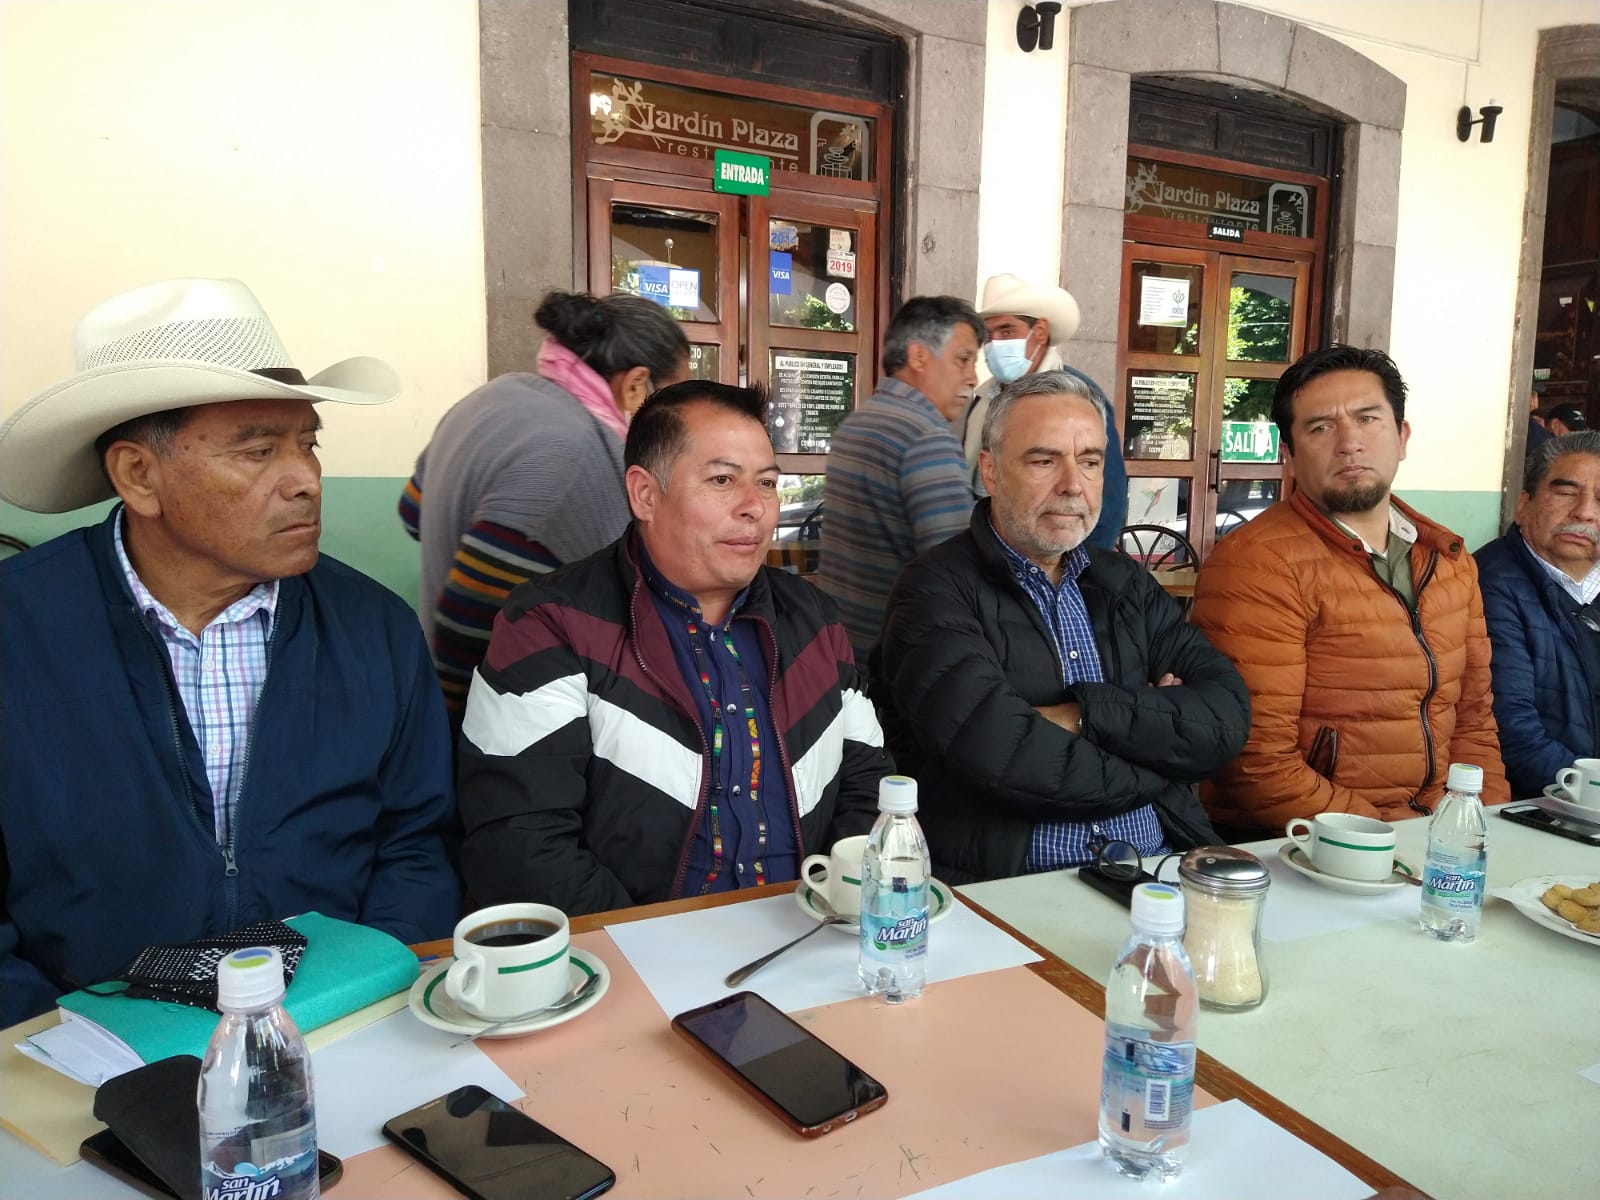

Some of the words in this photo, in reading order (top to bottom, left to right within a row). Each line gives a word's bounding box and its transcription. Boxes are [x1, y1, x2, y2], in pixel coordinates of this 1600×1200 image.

[642, 103, 724, 140] Jardín
[731, 118, 799, 151] Plaza
[667, 143, 799, 173] restnte
[720, 162, 765, 186] ENTRADA
[1156, 181, 1209, 208] Jardín
[1215, 191, 1260, 215] Plaza
[1212, 226, 1240, 238] SALIDA
[829, 259, 853, 273] 2019
[772, 270, 790, 280] VISA
[645, 282, 669, 294] VISA
[671, 279, 698, 290] OPEN
[1225, 431, 1274, 453] SALIA
[898, 918, 915, 928] san
[221, 1177, 250, 1190] san
